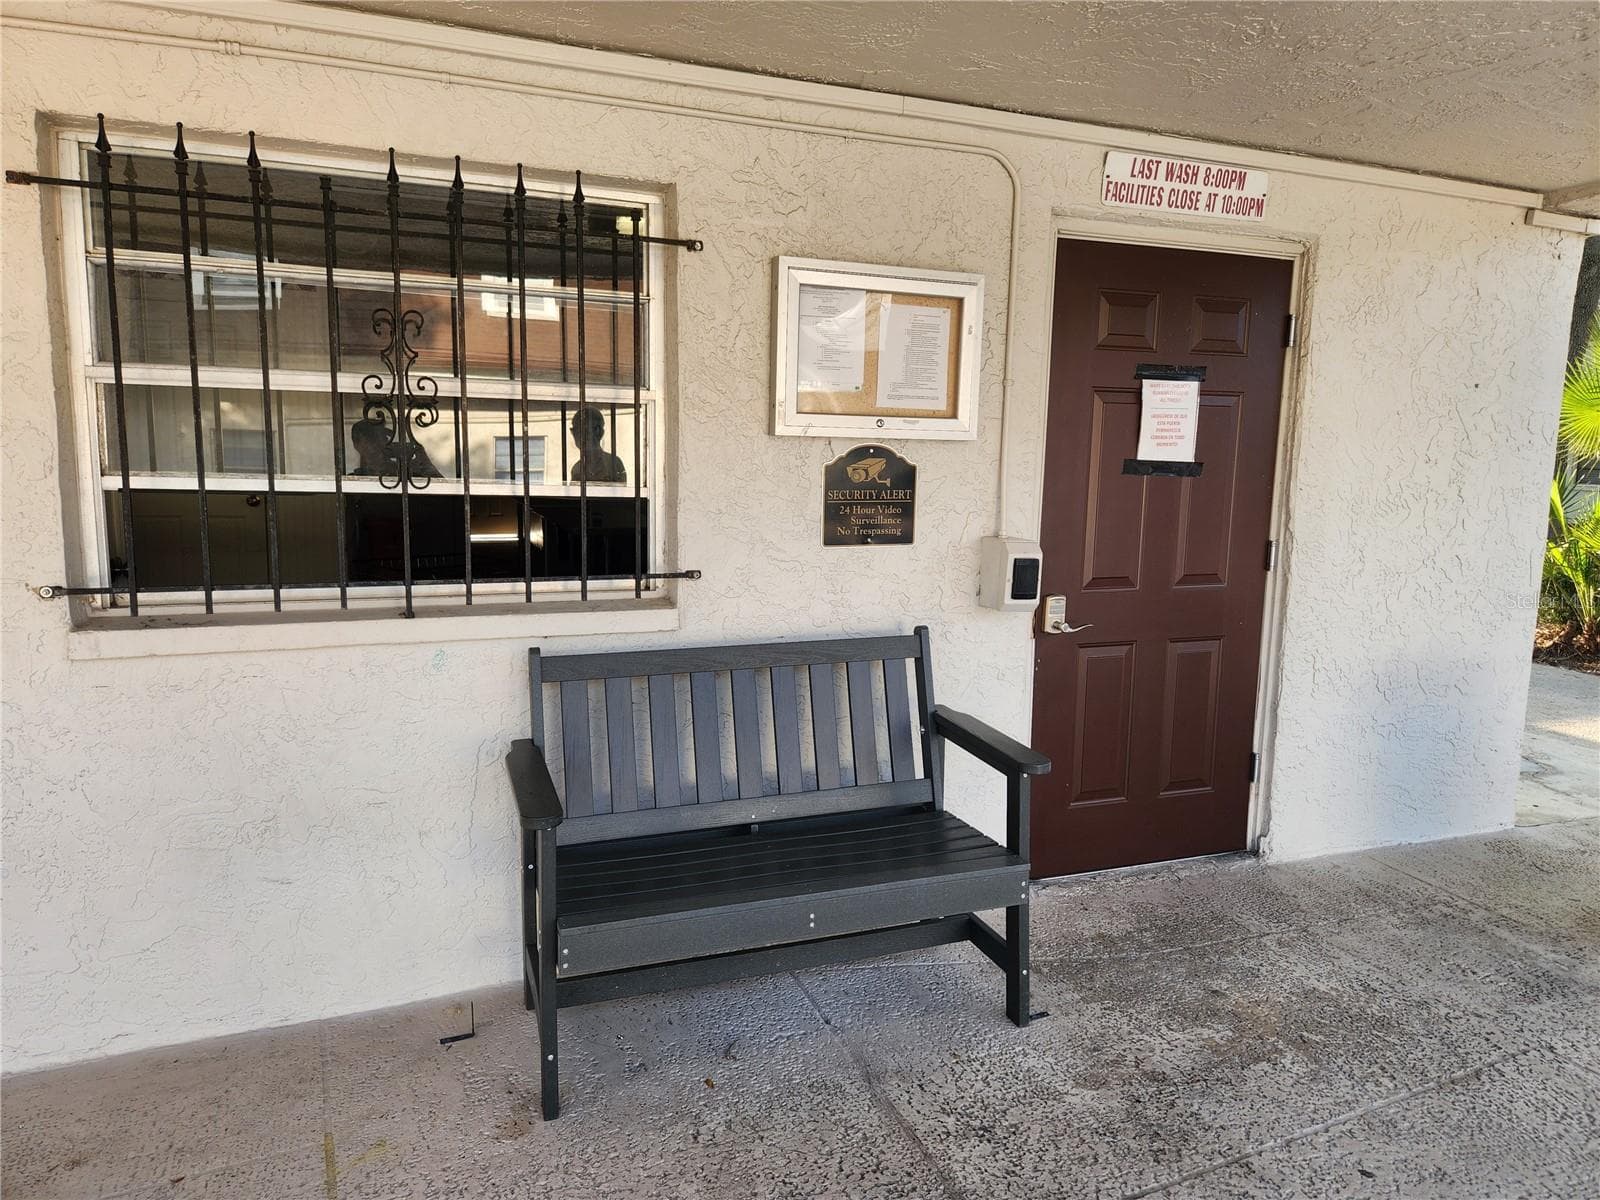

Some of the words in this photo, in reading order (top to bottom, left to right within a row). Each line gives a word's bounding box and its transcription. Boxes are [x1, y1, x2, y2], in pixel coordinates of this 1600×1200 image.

[1130, 157, 1162, 181] LAST
[1165, 161, 1200, 185] WASH
[1203, 166, 1247, 191] 8:00PM
[1104, 181, 1165, 207] FACILITIES
[1167, 188, 1202, 211] CLOSE
[1204, 192, 1218, 213] AT
[1221, 194, 1265, 218] 10:00PM
[827, 489, 878, 500] SECURITY
[880, 489, 913, 500] ALERT
[839, 505, 851, 515] 24
[852, 505, 876, 514] Hour
[877, 505, 902, 514] Video
[850, 515, 902, 525] Surveillance
[837, 526, 851, 536] No
[854, 526, 902, 537] Trespassing
